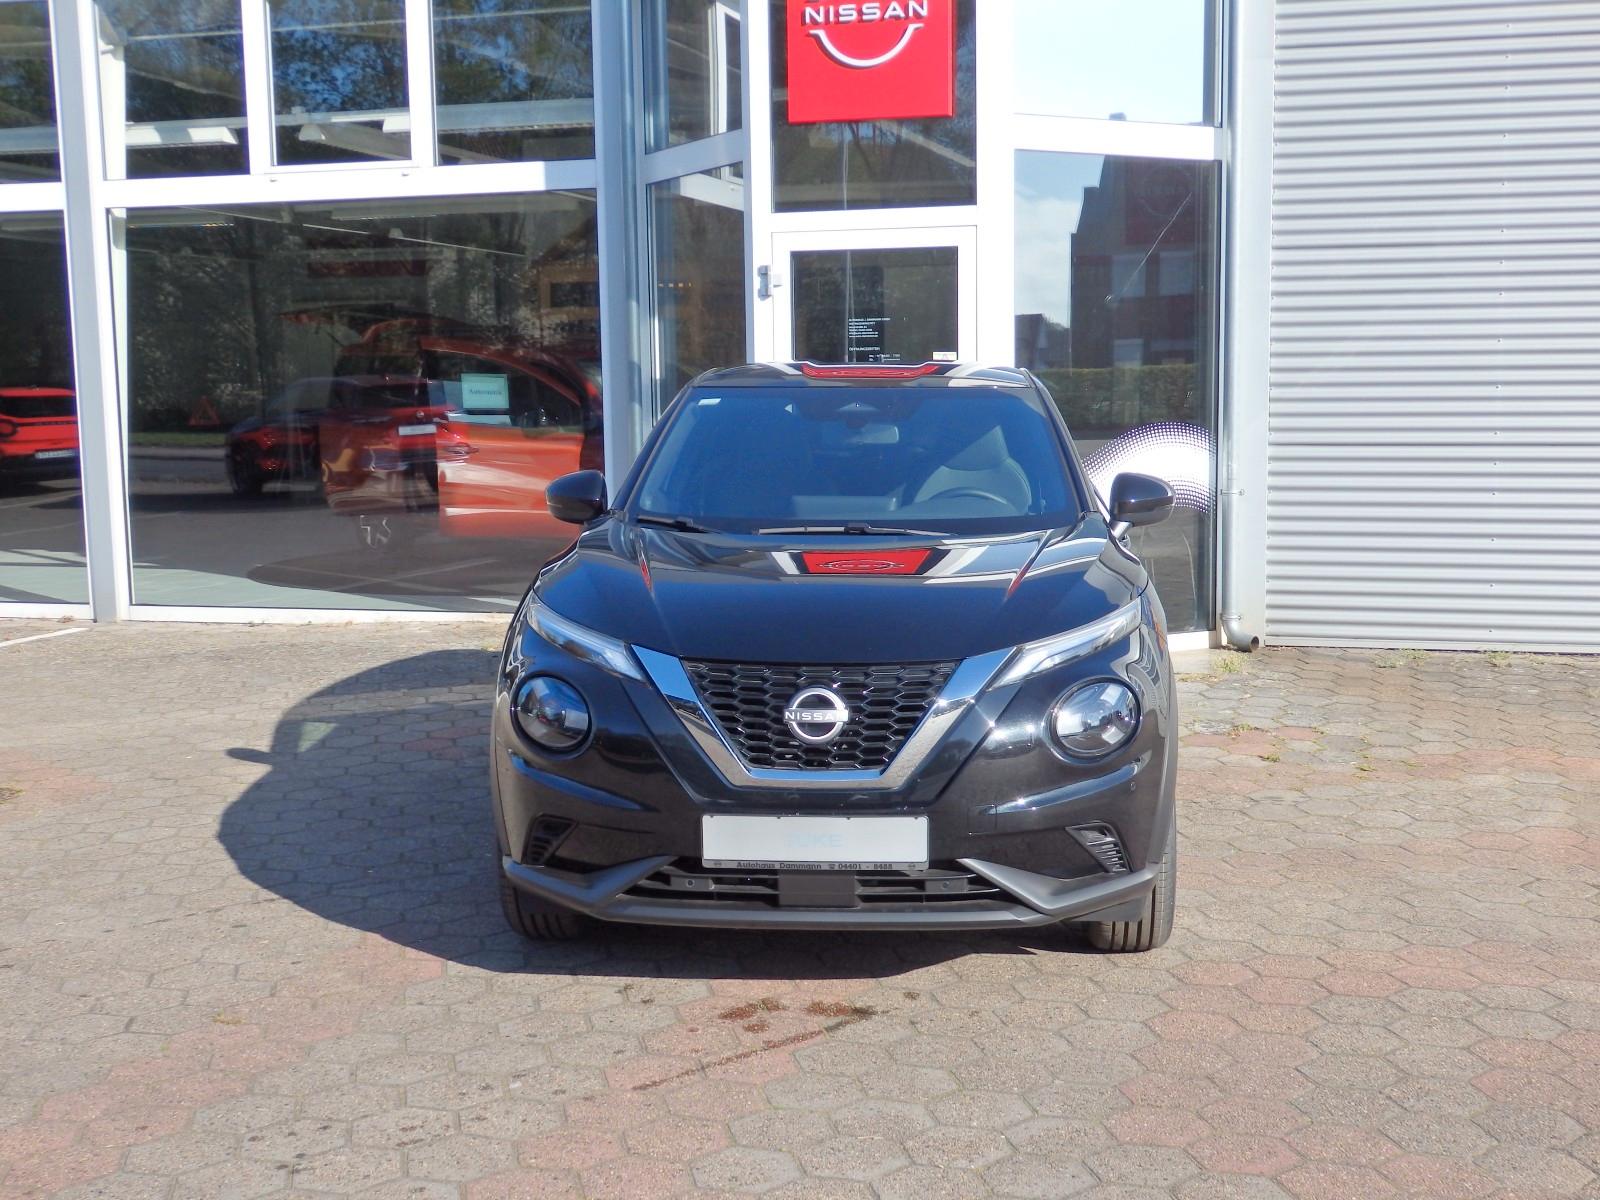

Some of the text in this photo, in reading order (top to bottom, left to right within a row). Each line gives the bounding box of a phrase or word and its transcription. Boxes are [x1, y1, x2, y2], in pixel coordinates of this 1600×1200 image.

[804, 0, 929, 25] NISSAN
[784, 711, 847, 721] NISSA
[736, 861, 776, 869] Autohaus
[779, 862, 822, 870] Dammann
